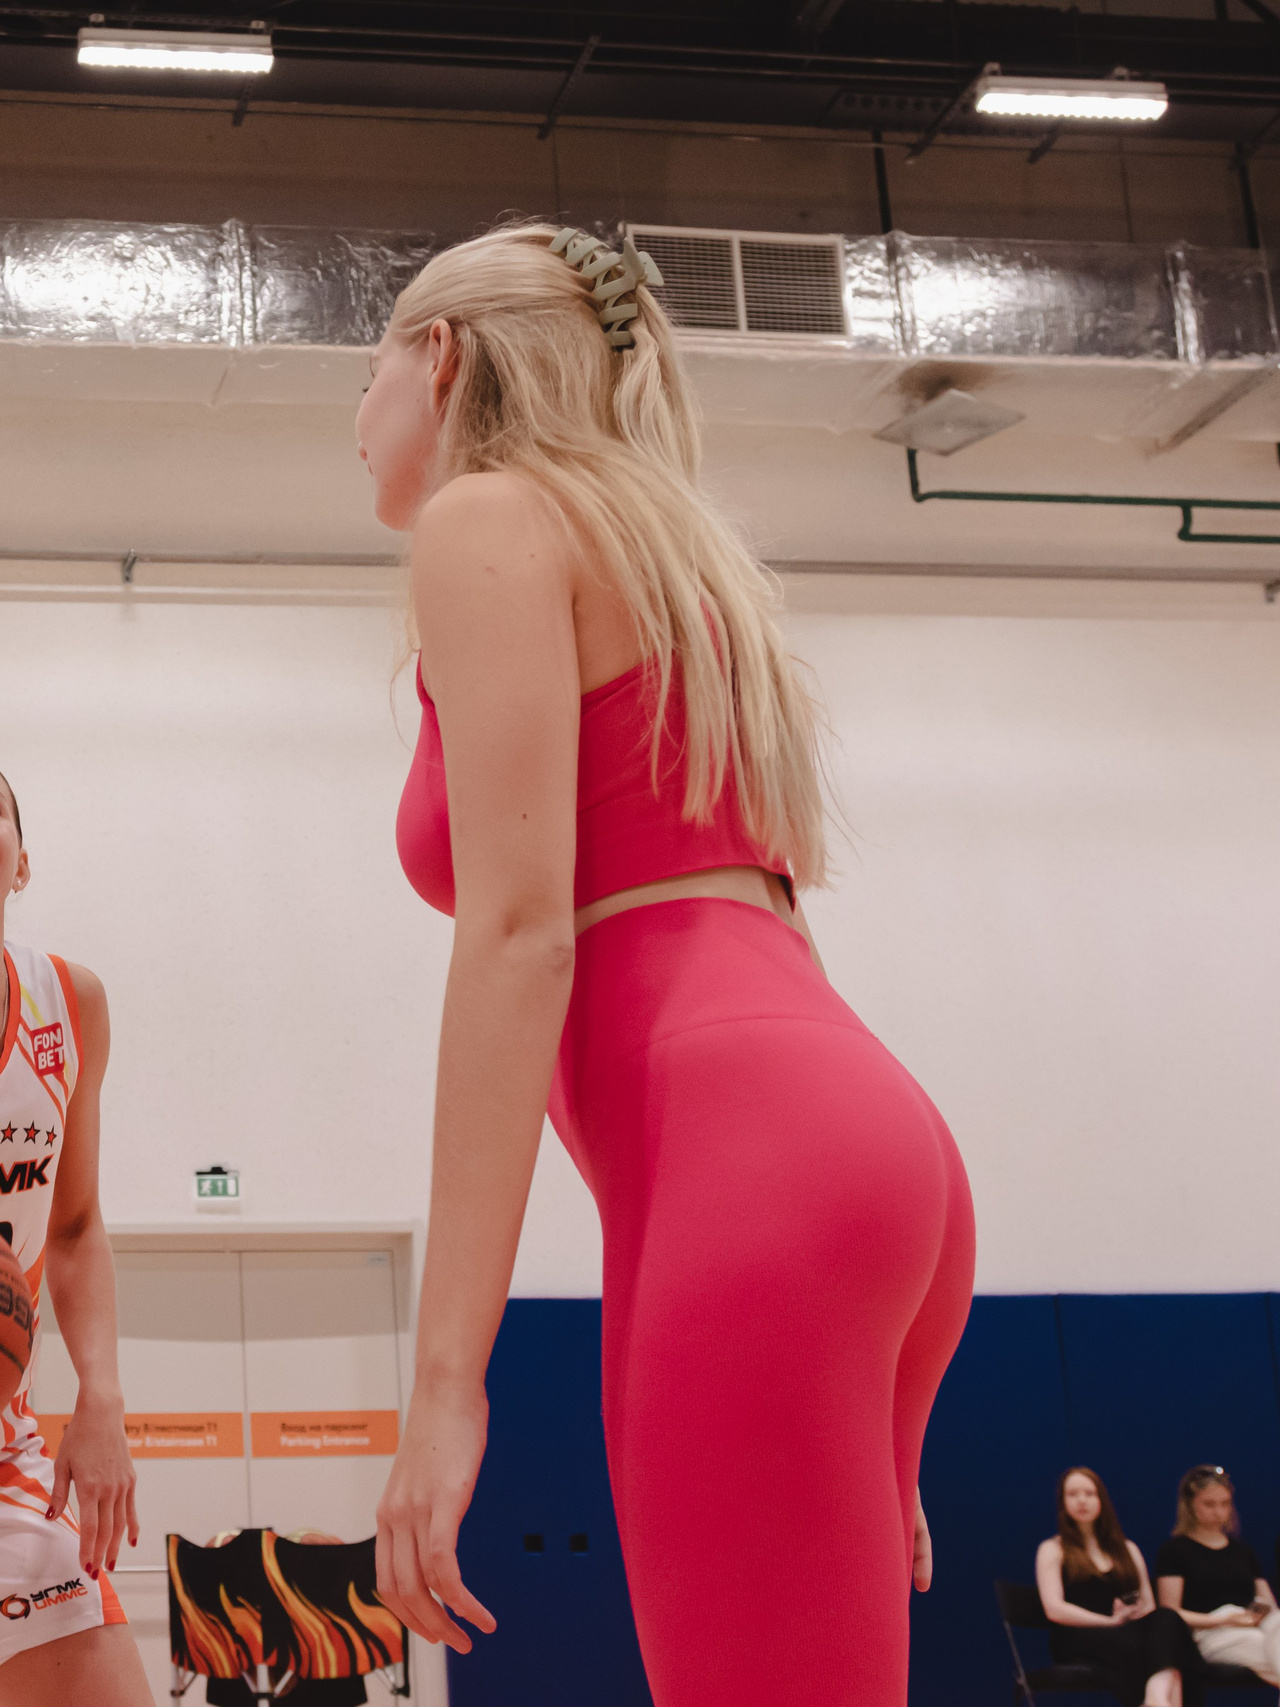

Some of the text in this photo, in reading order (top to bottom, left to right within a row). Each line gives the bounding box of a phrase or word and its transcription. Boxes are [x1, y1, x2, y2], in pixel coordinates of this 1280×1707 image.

[33, 1028, 62, 1052] FON
[37, 1046, 65, 1070] BET
[281, 1433, 370, 1450] Parking Entrance
[30, 1578, 84, 1602] УГМК
[34, 1587, 88, 1610] UMMC
